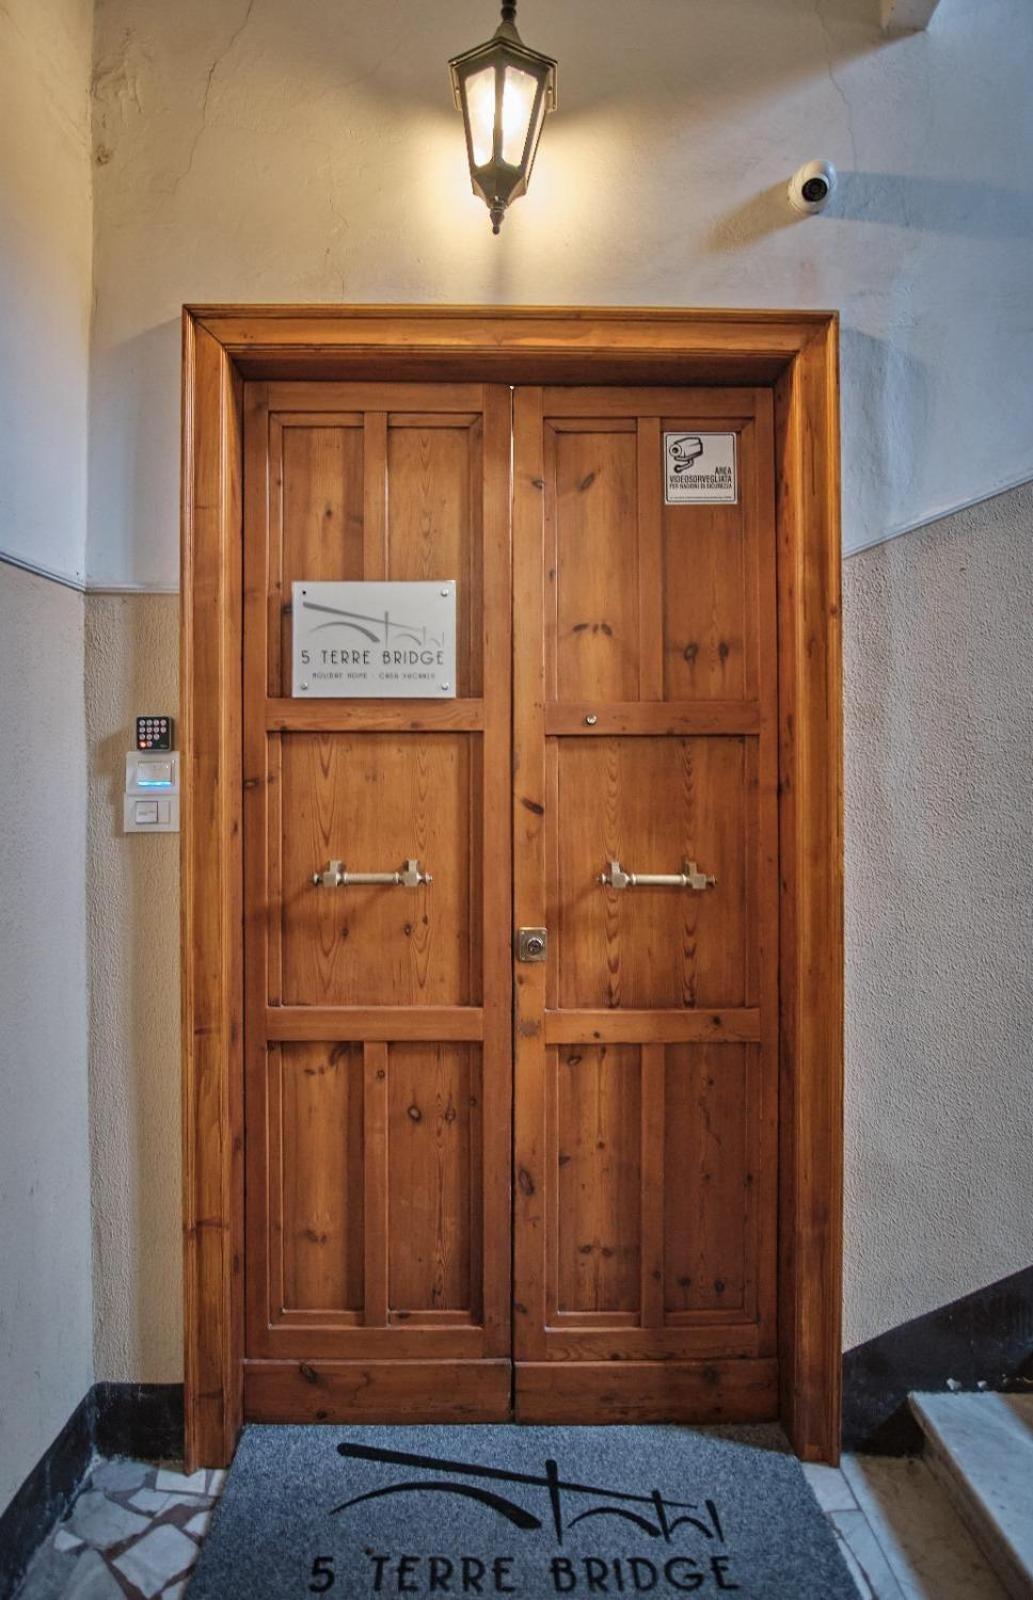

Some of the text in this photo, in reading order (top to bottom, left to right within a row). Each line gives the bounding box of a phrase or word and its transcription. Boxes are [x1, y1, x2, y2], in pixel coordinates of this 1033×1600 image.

[714, 466, 732, 474] AREA
[301, 650, 445, 666] 5 TERRE BRIDGE
[309, 1554, 740, 1593] 5 TERRE BRIDGE
